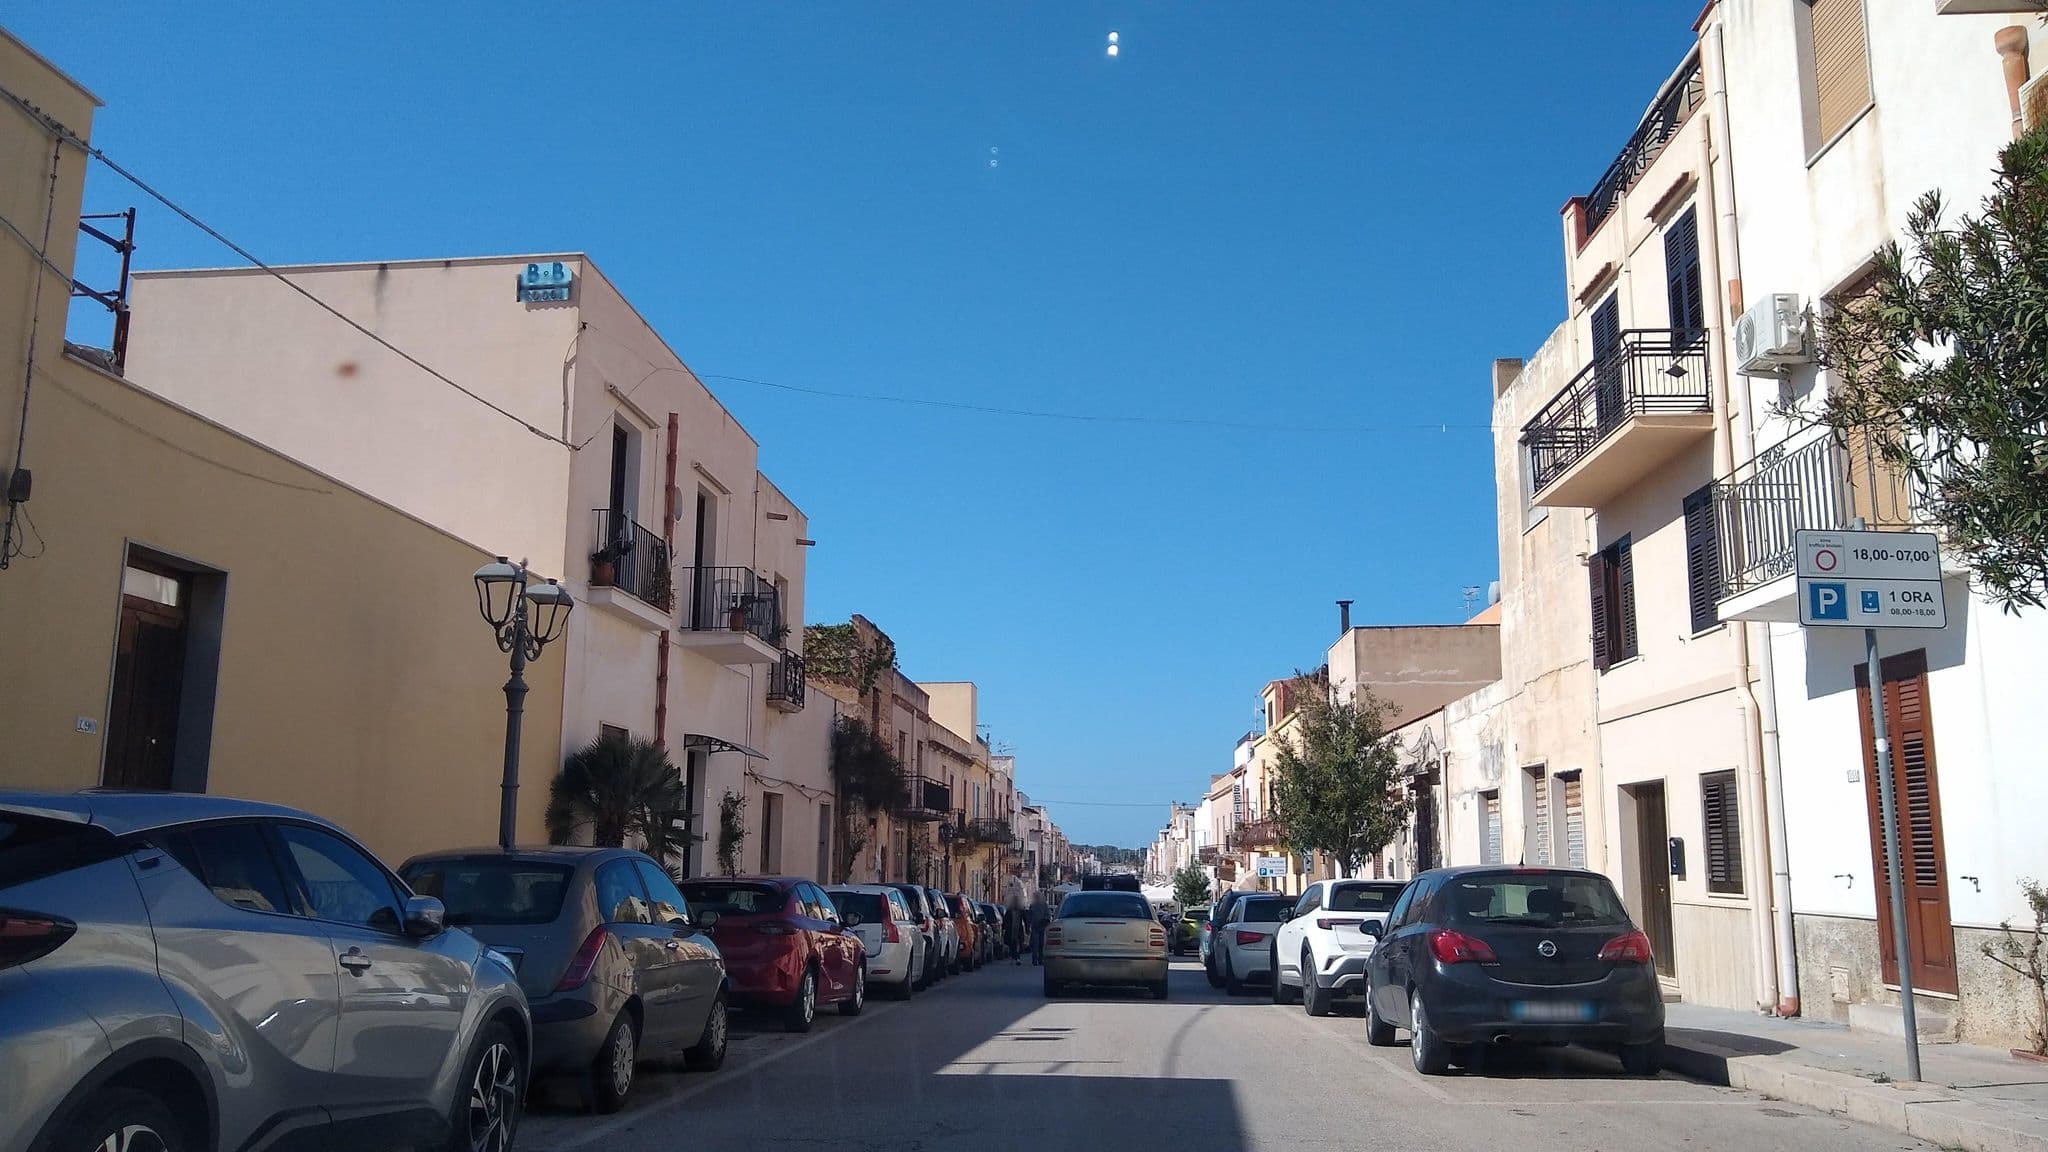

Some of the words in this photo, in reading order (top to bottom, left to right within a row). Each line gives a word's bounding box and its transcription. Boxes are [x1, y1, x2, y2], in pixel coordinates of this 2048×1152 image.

[1853, 548, 1930, 562] 18,00-07,00
[1818, 588, 1838, 615] P
[1889, 591, 1896, 603] 1
[1901, 591, 1934, 603] ORA
